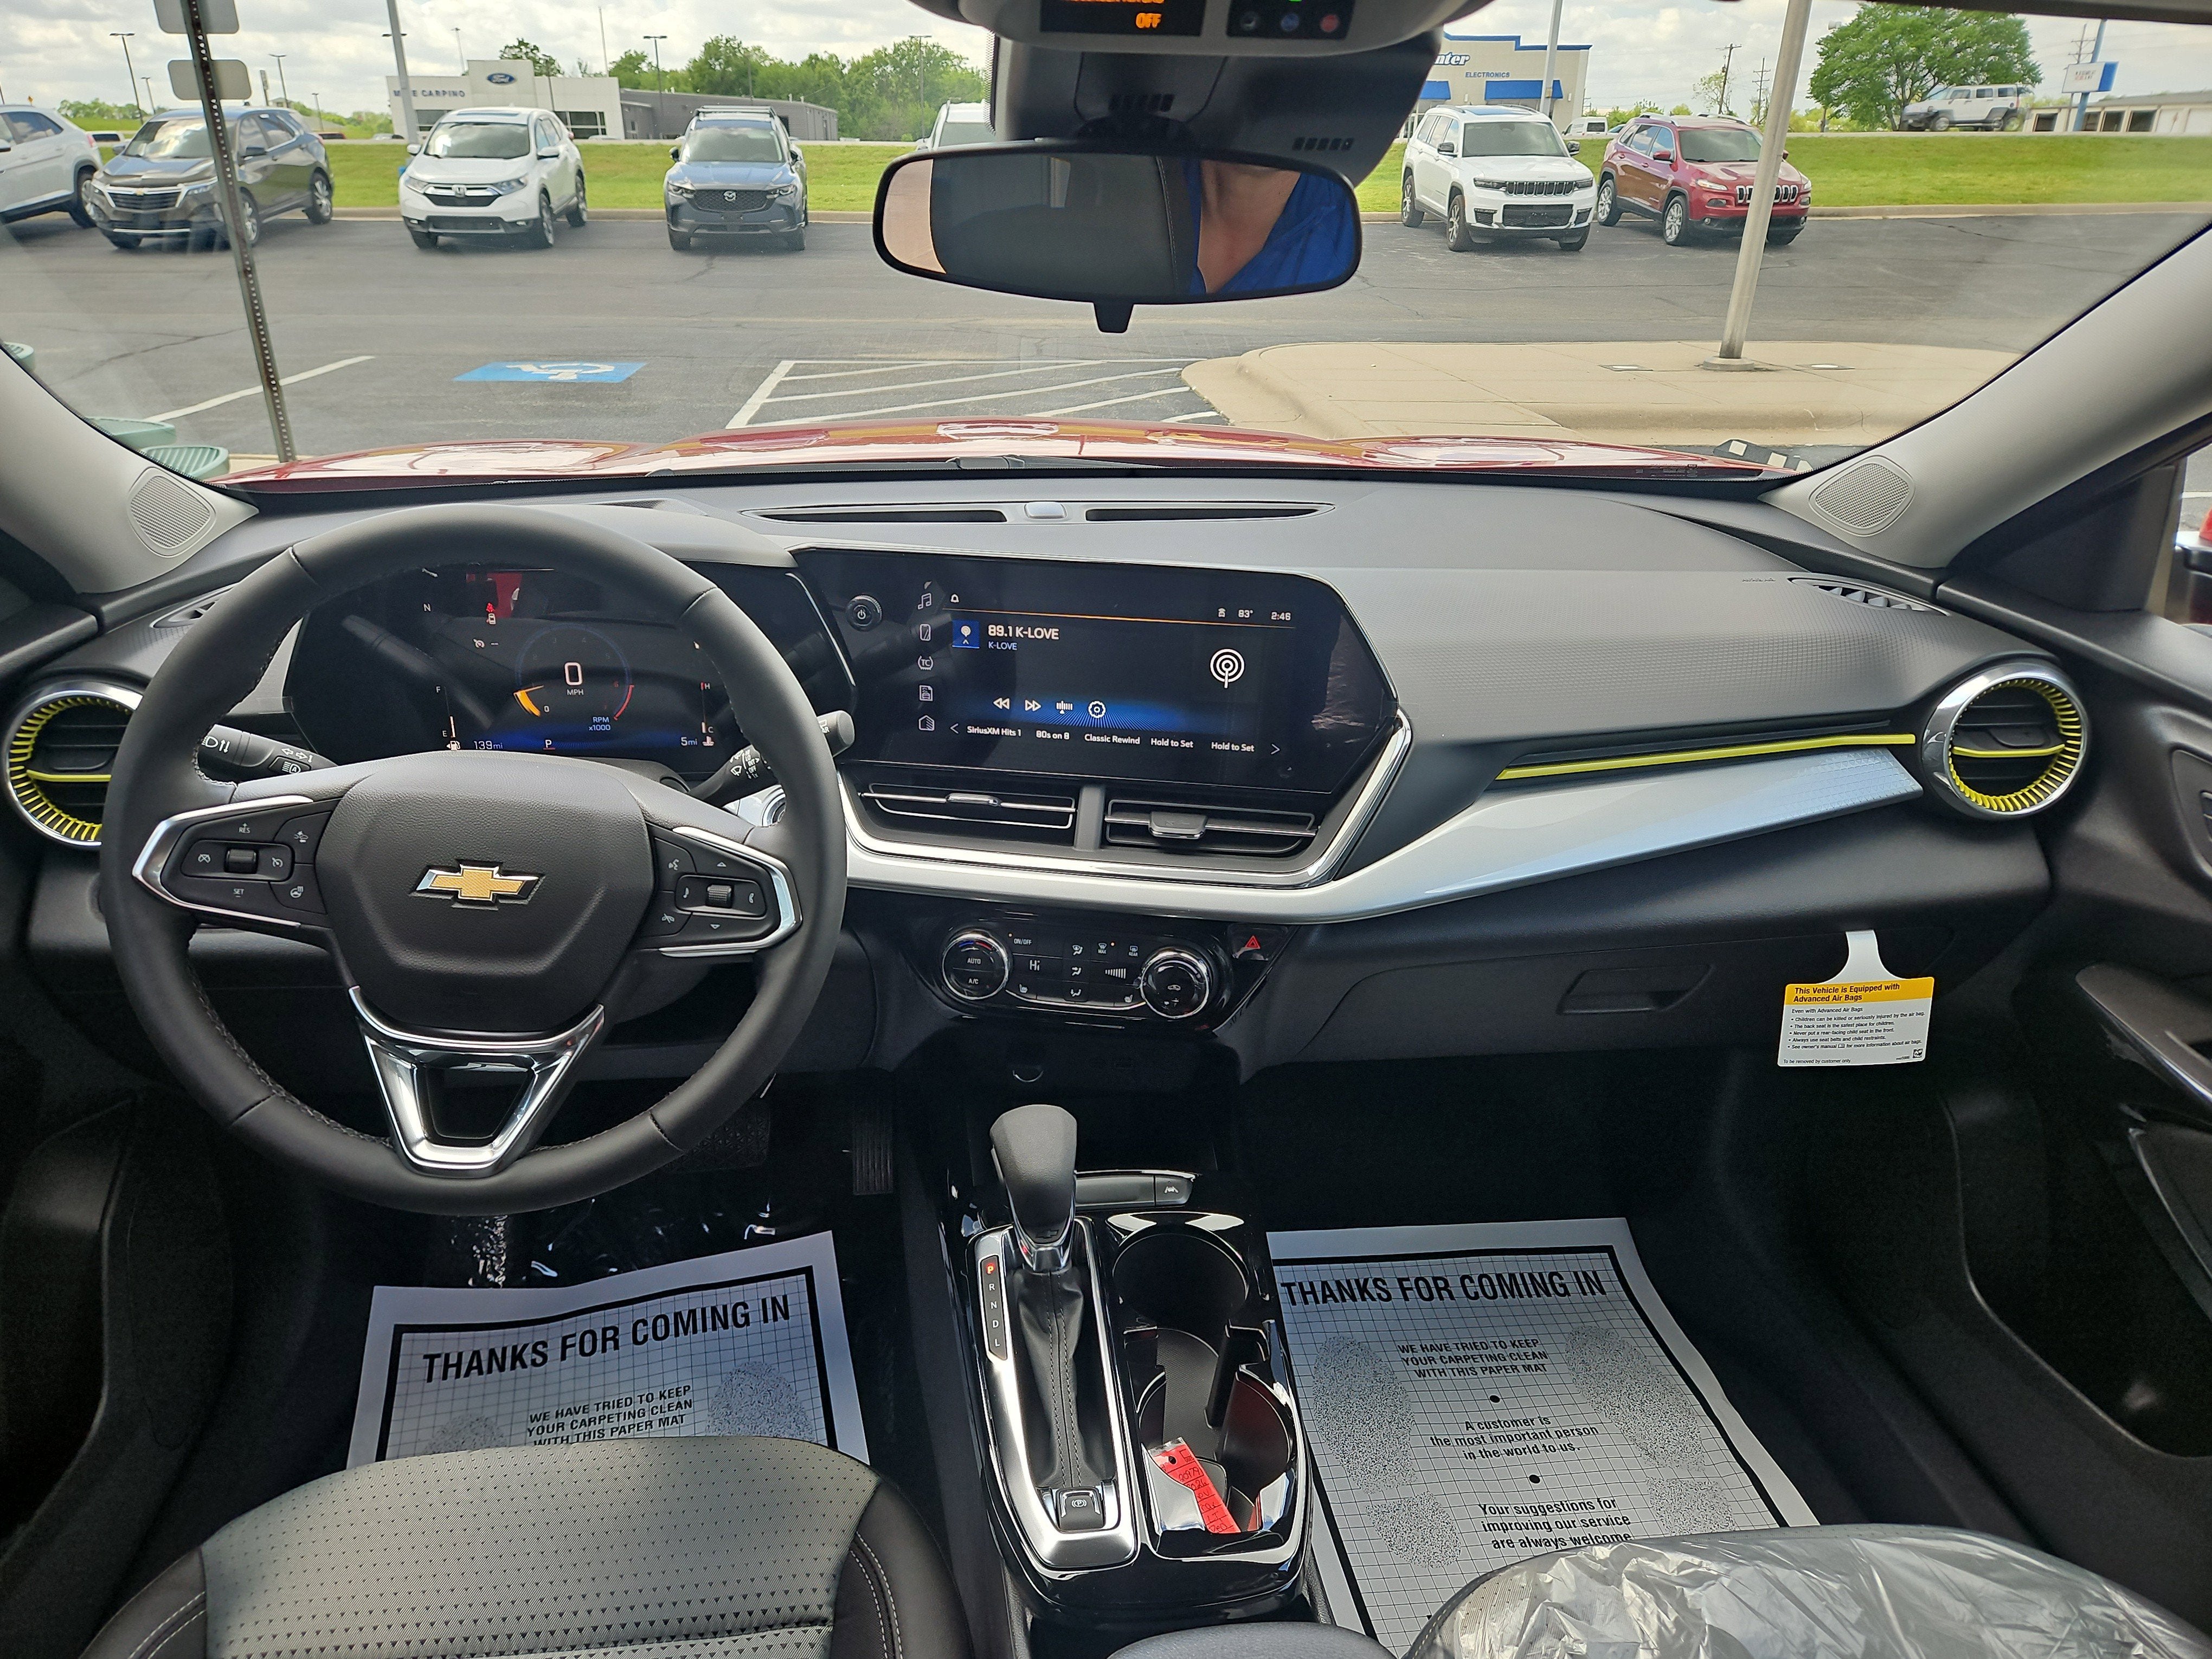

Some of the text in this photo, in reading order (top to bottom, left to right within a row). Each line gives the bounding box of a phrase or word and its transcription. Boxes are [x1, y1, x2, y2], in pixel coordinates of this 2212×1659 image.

[1136, 12, 1162, 28] OFF
[1435, 52, 1470, 65] nter
[423, 603, 431, 612] N
[1271, 612, 1291, 621] 2:46
[988, 625, 1059, 640] 89.1 K-LOVE
[988, 641, 1018, 651] K-LOVE
[564, 662, 583, 685] 0
[967, 725, 1021, 737] SiriusXM Hits 1
[545, 740, 552, 748] P
[1084, 734, 1140, 745] Classic Rewind
[1150, 738, 1169, 747] Hold
[1180, 740, 1193, 748] Set
[1211, 742, 1230, 751] Hold
[1241, 744, 1255, 753] Set
[748, 765, 757, 774] OFF
[1030, 960, 1040, 970] Hi
[1849, 984, 1882, 993] Equipped
[987, 1265, 994, 1274] P
[1280, 1270, 1607, 1306] THANKS FOR COMING IN
[991, 1301, 998, 1309] N
[423, 1294, 790, 1383] THANKS FOR COMING IN
[994, 1338, 1000, 1347] L
[1397, 1339, 1539, 1354] WE HAVE TRIED TO KEEP
[1402, 1351, 1548, 1366] YOUR CARPETING CLEAN
[1413, 1362, 1548, 1379] WITH THIS PAPER MAT
[529, 1385, 691, 1424] WE HAVE TRIED TO KEEP
[526, 1399, 692, 1437] YOUR CARPETING CLEAN
[1465, 1416, 1552, 1431] A customer is
[533, 1413, 686, 1446] WITH THIS PAPER MAT
[1430, 1426, 1599, 1446] the most important person
[1462, 1442, 1581, 1461] in the world to us.
[1478, 1497, 1617, 1516] Your suggestions for
[1481, 1514, 1631, 1533] improving our service
[1491, 1533, 1632, 1549] are always welcome
